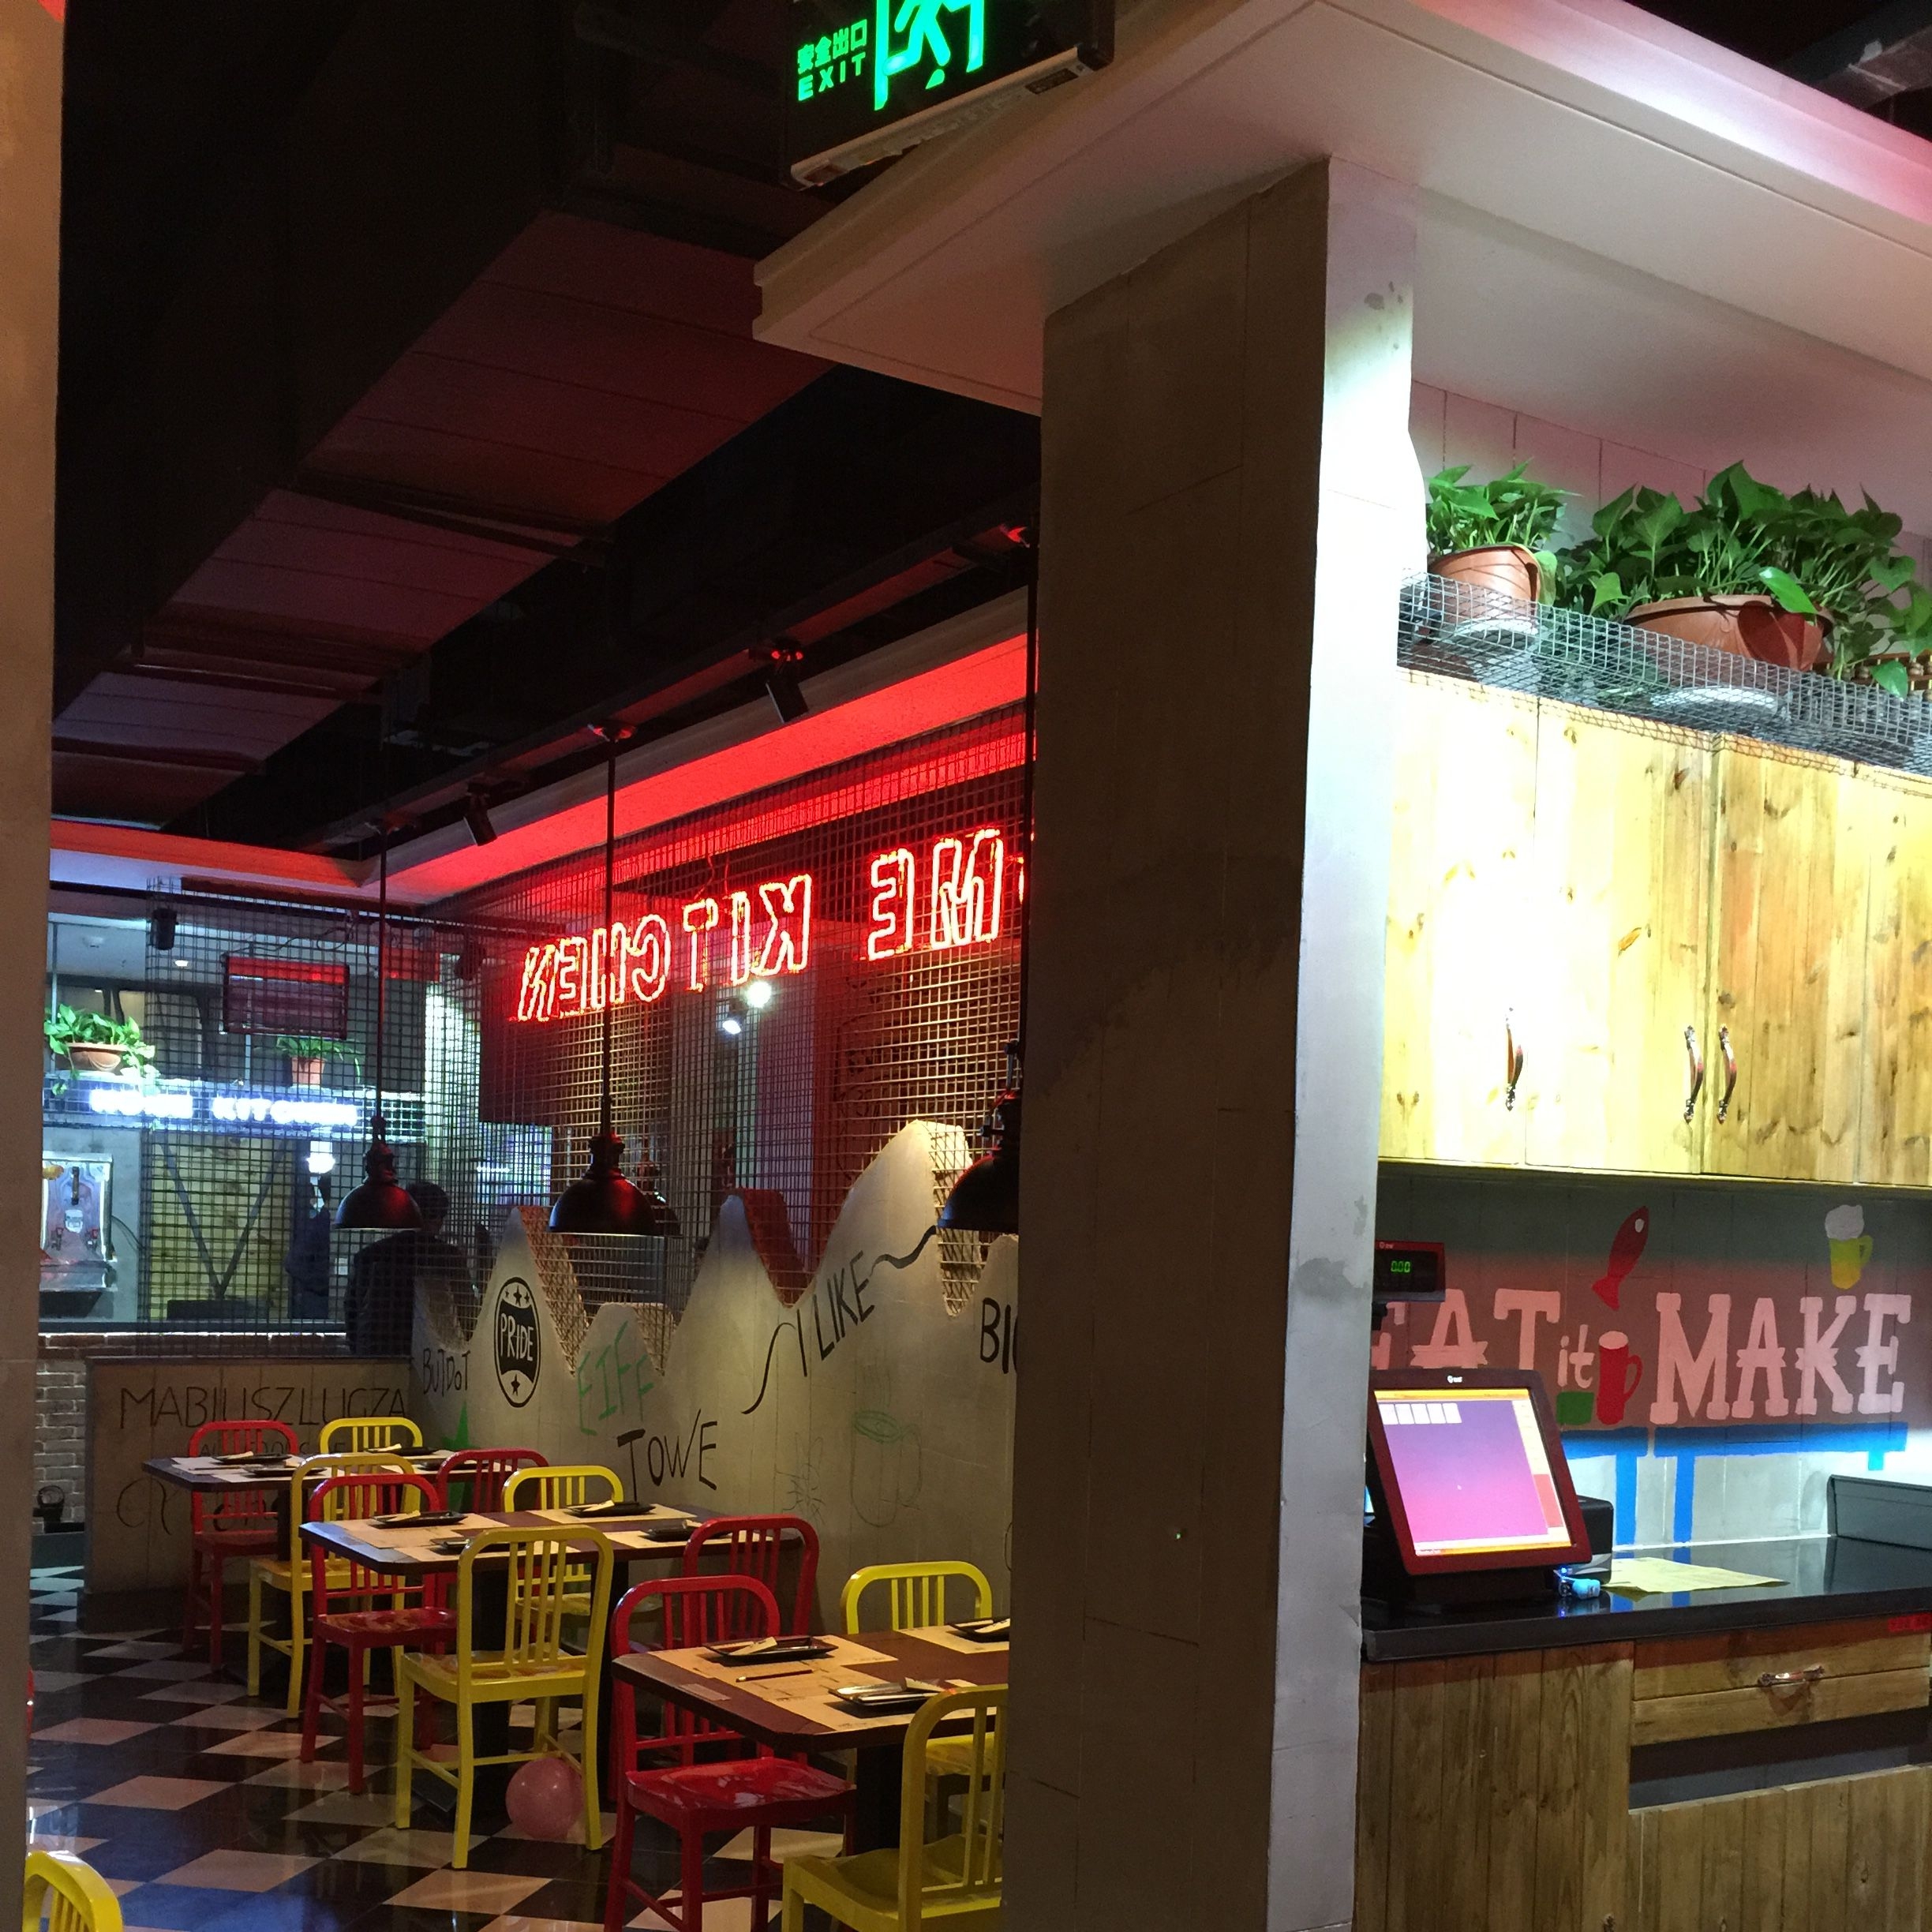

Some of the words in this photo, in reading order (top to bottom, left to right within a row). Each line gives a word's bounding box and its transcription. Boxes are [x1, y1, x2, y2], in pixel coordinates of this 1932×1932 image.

[798, 19, 867, 74] 安全出口
[799, 52, 866, 101] EXIT
[500, 1312, 534, 1362] PRIDE
[814, 1250, 875, 1361] LIKE
[980, 1297, 1018, 1375] BI
[1557, 1324, 1595, 1389] it
[1650, 1292, 1911, 1425] MAKE
